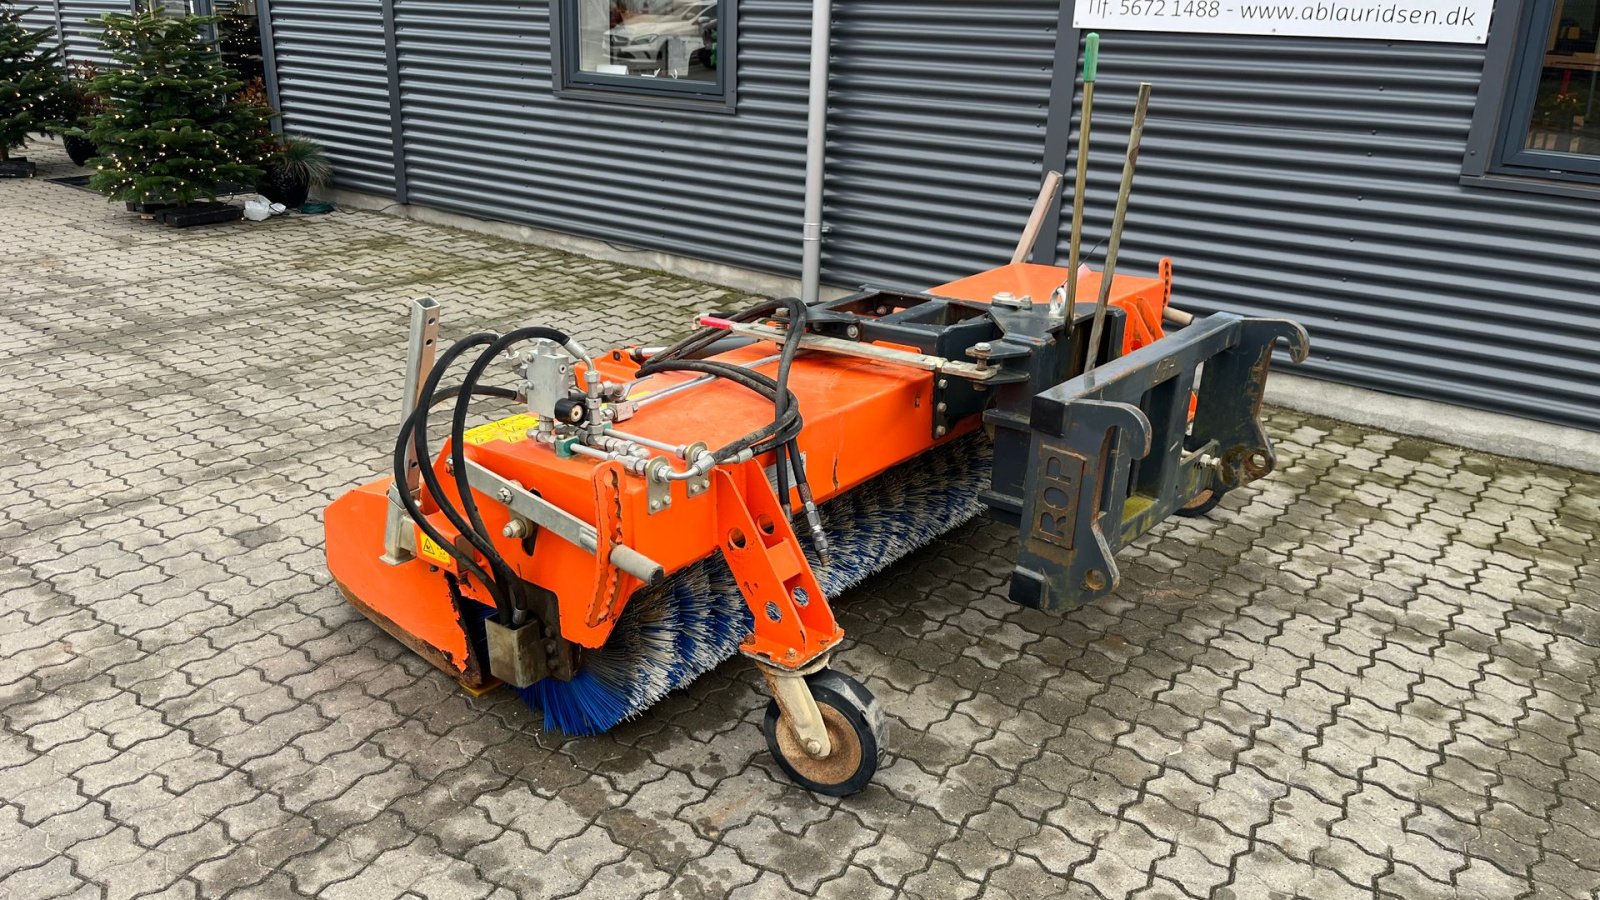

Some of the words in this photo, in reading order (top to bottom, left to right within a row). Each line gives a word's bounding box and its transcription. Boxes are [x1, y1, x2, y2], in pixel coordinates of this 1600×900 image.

[1119, 0, 1165, 16] 5672
[1170, 0, 1220, 18] 1488
[1240, 2, 1475, 26] www.ablauridsen.dk
